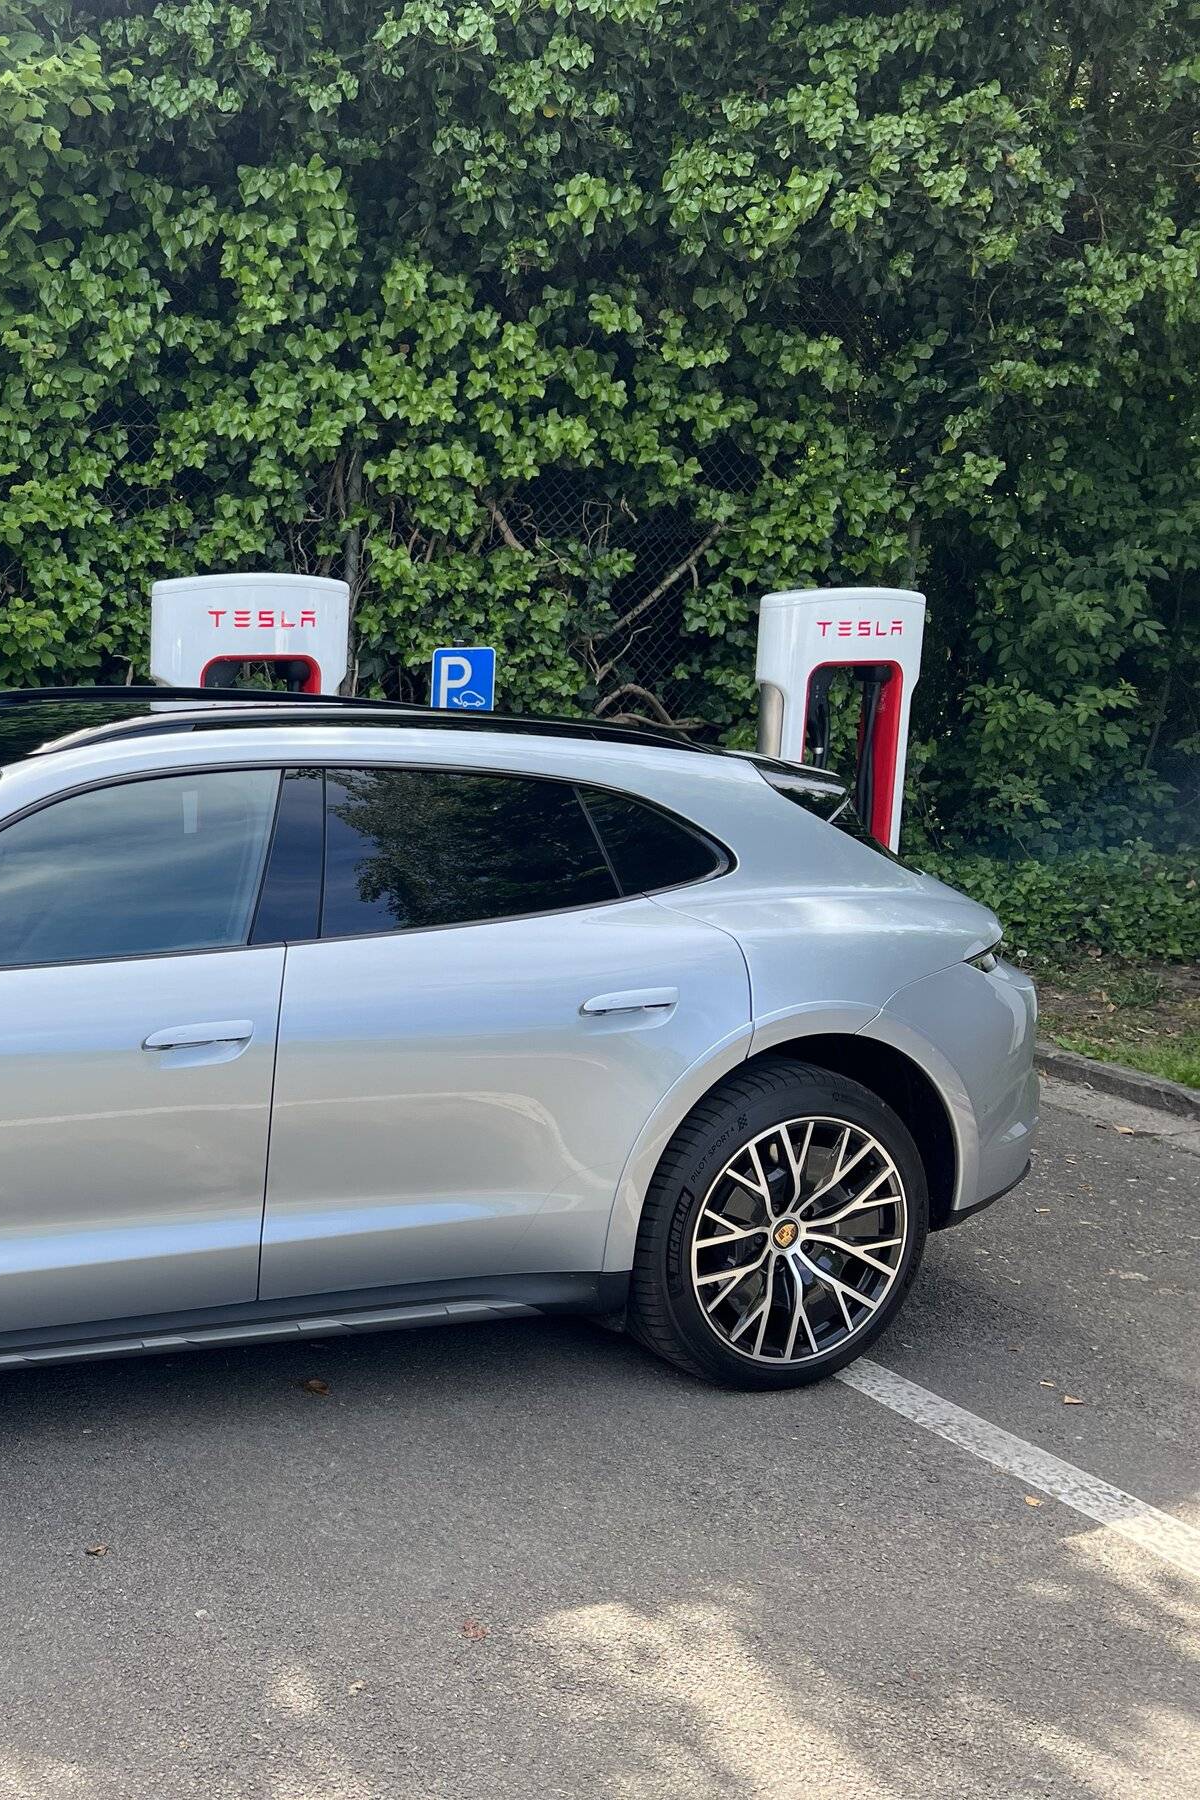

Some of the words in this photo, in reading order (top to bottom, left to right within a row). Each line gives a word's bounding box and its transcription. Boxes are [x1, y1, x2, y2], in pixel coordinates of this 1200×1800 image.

[208, 610, 316, 628] TESLA
[816, 620, 903, 637] TESLA
[439, 656, 472, 708] P
[690, 1157, 708, 1183] PILOT
[708, 1132, 731, 1157] SPORT
